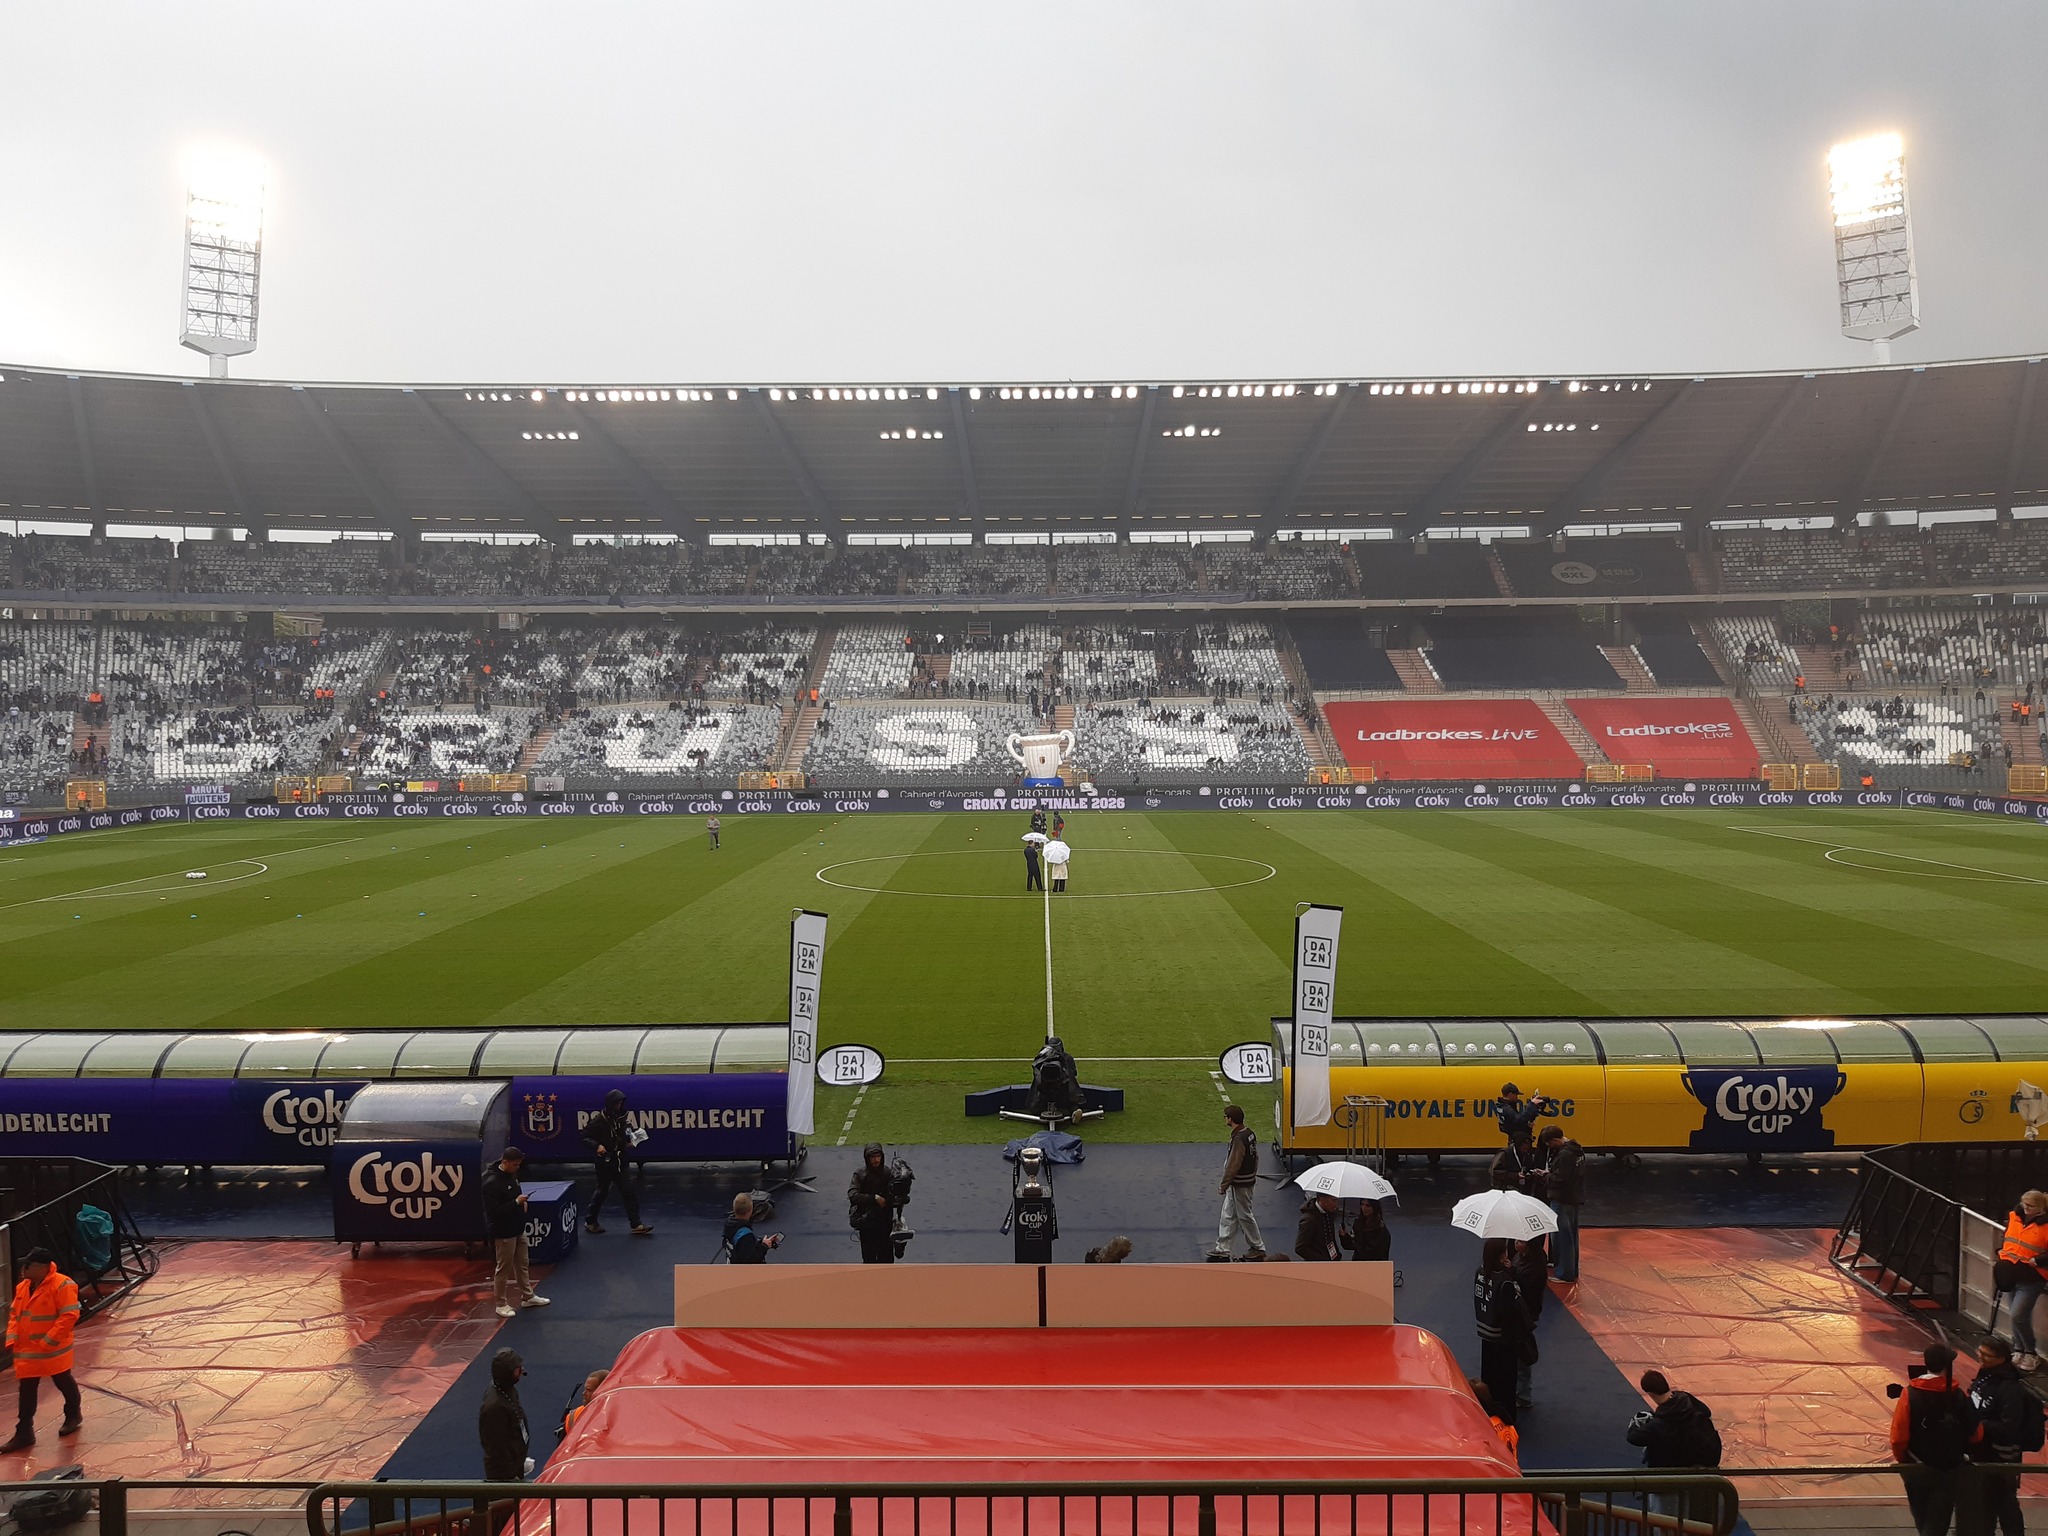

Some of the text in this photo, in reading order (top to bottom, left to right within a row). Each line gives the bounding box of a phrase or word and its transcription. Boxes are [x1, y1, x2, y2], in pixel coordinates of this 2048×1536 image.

[1606, 721, 1731, 738] Ladbrokes
[191, 785, 225, 794] MAUVE
[416, 794, 452, 803] Cabinet
[628, 792, 664, 801] Cabinet
[900, 790, 936, 798] Cabinet
[1378, 786, 1414, 794] Cabinet
[1590, 784, 1627, 793] Cabinet
[195, 805, 231, 819] Croky
[245, 805, 280, 818] Croky
[295, 804, 330, 817] Croky
[344, 804, 379, 816] Croky
[393, 804, 429, 816] Croky
[443, 803, 478, 816] Croky
[492, 802, 528, 815] Croky
[540, 802, 576, 814] Croky
[590, 802, 625, 814] Croky
[639, 801, 674, 814] Croky
[688, 800, 723, 814] Croky
[737, 800, 772, 813] Croky
[786, 800, 821, 813] Croky
[835, 799, 870, 812] Croky
[963, 798, 1007, 810] CROKY
[1011, 798, 1036, 810] CUP
[1040, 798, 1088, 810] FINALE
[1091, 798, 1126, 809] 2026
[1219, 796, 1254, 808] Croky
[1268, 796, 1302, 808] Croky
[1317, 795, 1352, 808] Croky
[1366, 795, 1400, 808] Croky
[1415, 794, 1450, 807] Croky
[1464, 794, 1499, 807] Croky
[1514, 794, 1548, 807] Croky
[1561, 794, 1596, 806] Croky
[1610, 793, 1646, 806] Croky
[1660, 793, 1695, 806] Croky
[1709, 792, 1744, 805] Croky
[1758, 792, 1794, 805] Croky
[1808, 792, 1842, 804] Croky
[1857, 791, 1892, 804] Croky
[1907, 792, 1936, 805] Croky
[1974, 798, 1996, 812] Croky
[2004, 801, 2027, 815] Croky
[0, 807, 180, 838] oky Croky Croky Croky Croky Croky
[1385, 1098, 1465, 1118] ROYALE
[1715, 1076, 1814, 1121] Croky
[627, 1108, 765, 1129] ANDERLECHT
[1748, 1114, 1793, 1133] CUP
[349, 1151, 464, 1205] Croky
[390, 1197, 442, 1219] CUP
[1018, 1210, 1048, 1225] Croky
[524, 1218, 551, 1237] oky
[527, 1237, 542, 1247] UP
